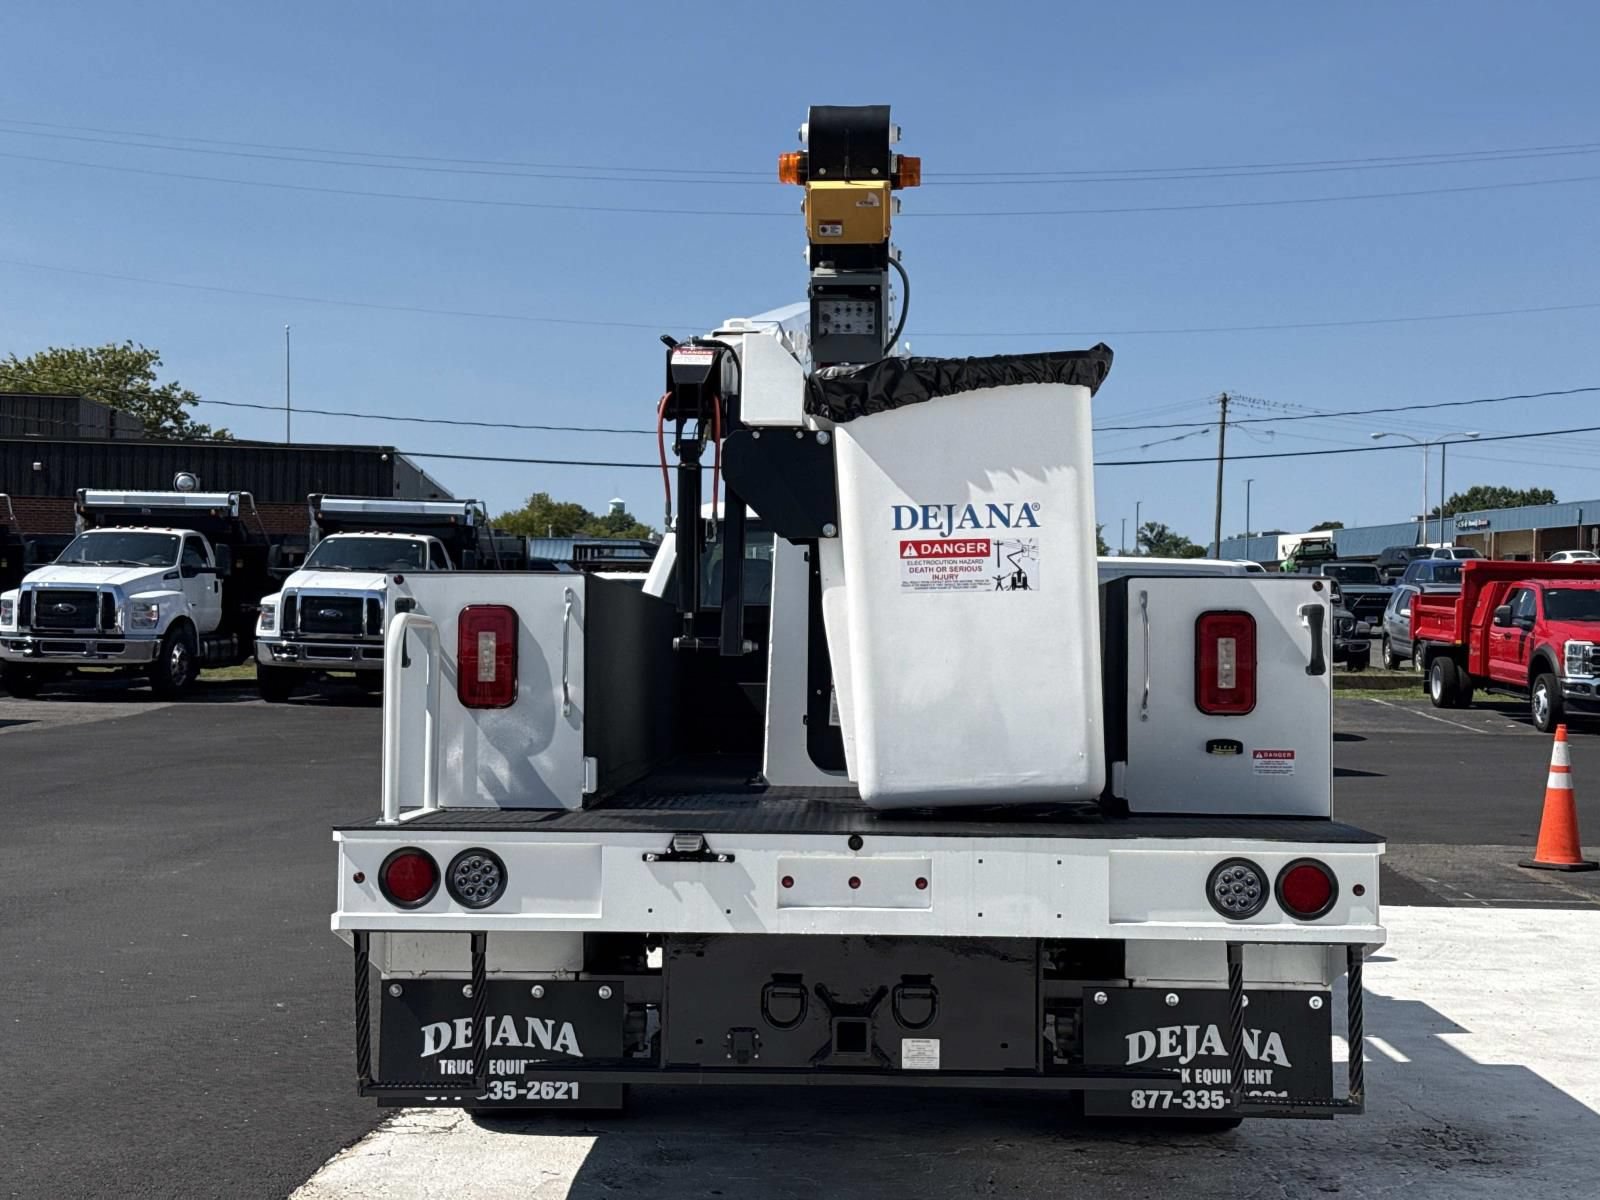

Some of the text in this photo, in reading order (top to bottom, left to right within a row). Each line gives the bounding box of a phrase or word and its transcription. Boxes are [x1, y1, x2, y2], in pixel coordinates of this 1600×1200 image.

[920, 542, 988, 555] DANGER
[907, 558, 984, 567] ELECTROCUTION HAZARD
[909, 566, 935, 574] DEATH
[949, 565, 983, 573] SERIOUS
[439, 1059, 474, 1075] TRUC
[1131, 1089, 1289, 1110] 877-335-
